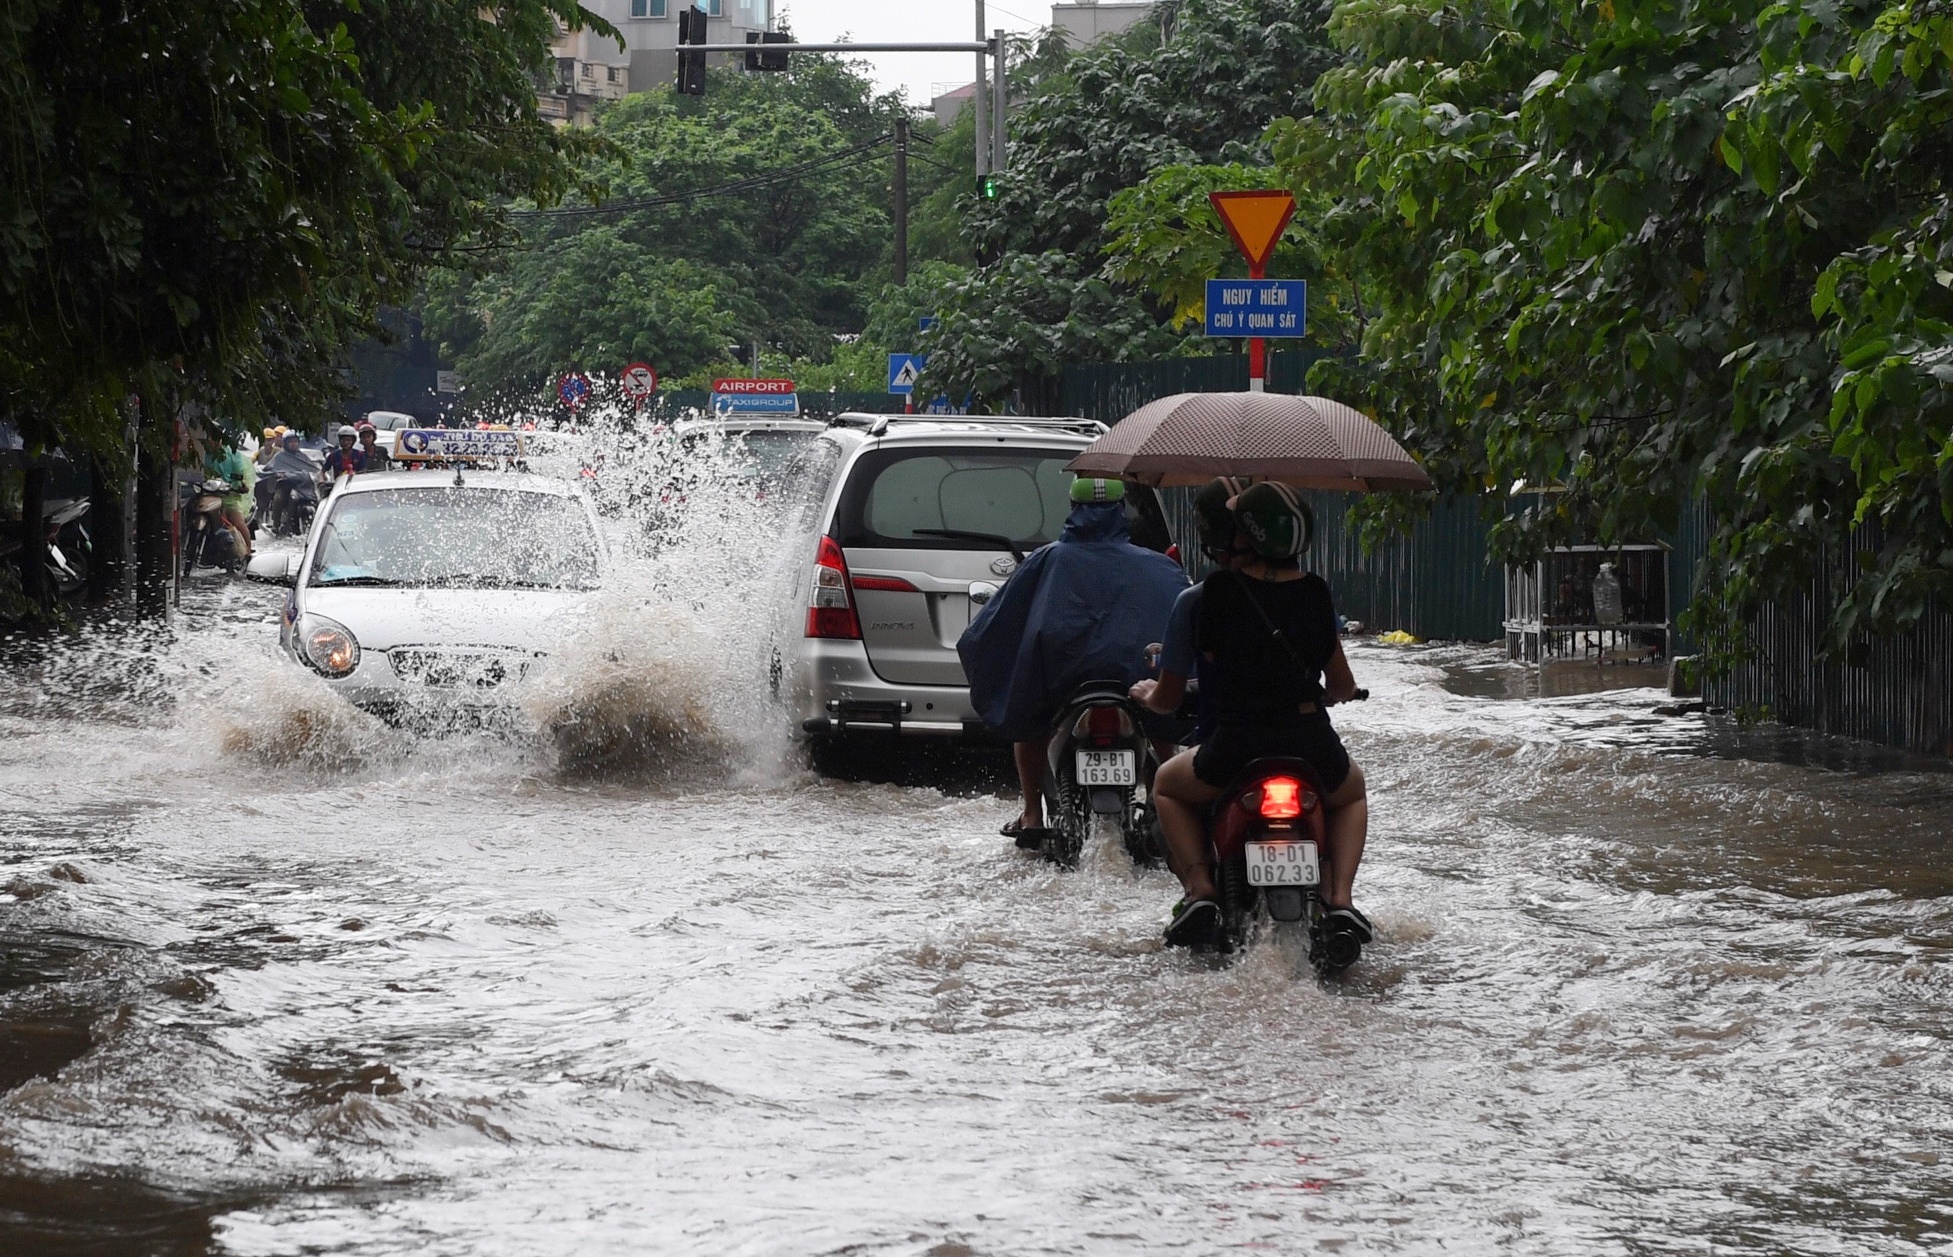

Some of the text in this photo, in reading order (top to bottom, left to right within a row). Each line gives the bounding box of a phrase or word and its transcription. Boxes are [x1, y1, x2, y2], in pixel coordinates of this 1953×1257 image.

[1223, 282, 1287, 306] NGUY HIỂM
[1214, 311, 1296, 329] CHÚ Ý QUAN SÁT
[720, 382, 788, 392] AIRPORT
[1085, 752, 1125, 767] 29-B1
[1082, 768, 1131, 783] 163.69
[1258, 845, 1306, 863] 18-D1
[1252, 864, 1315, 882] 062.33
